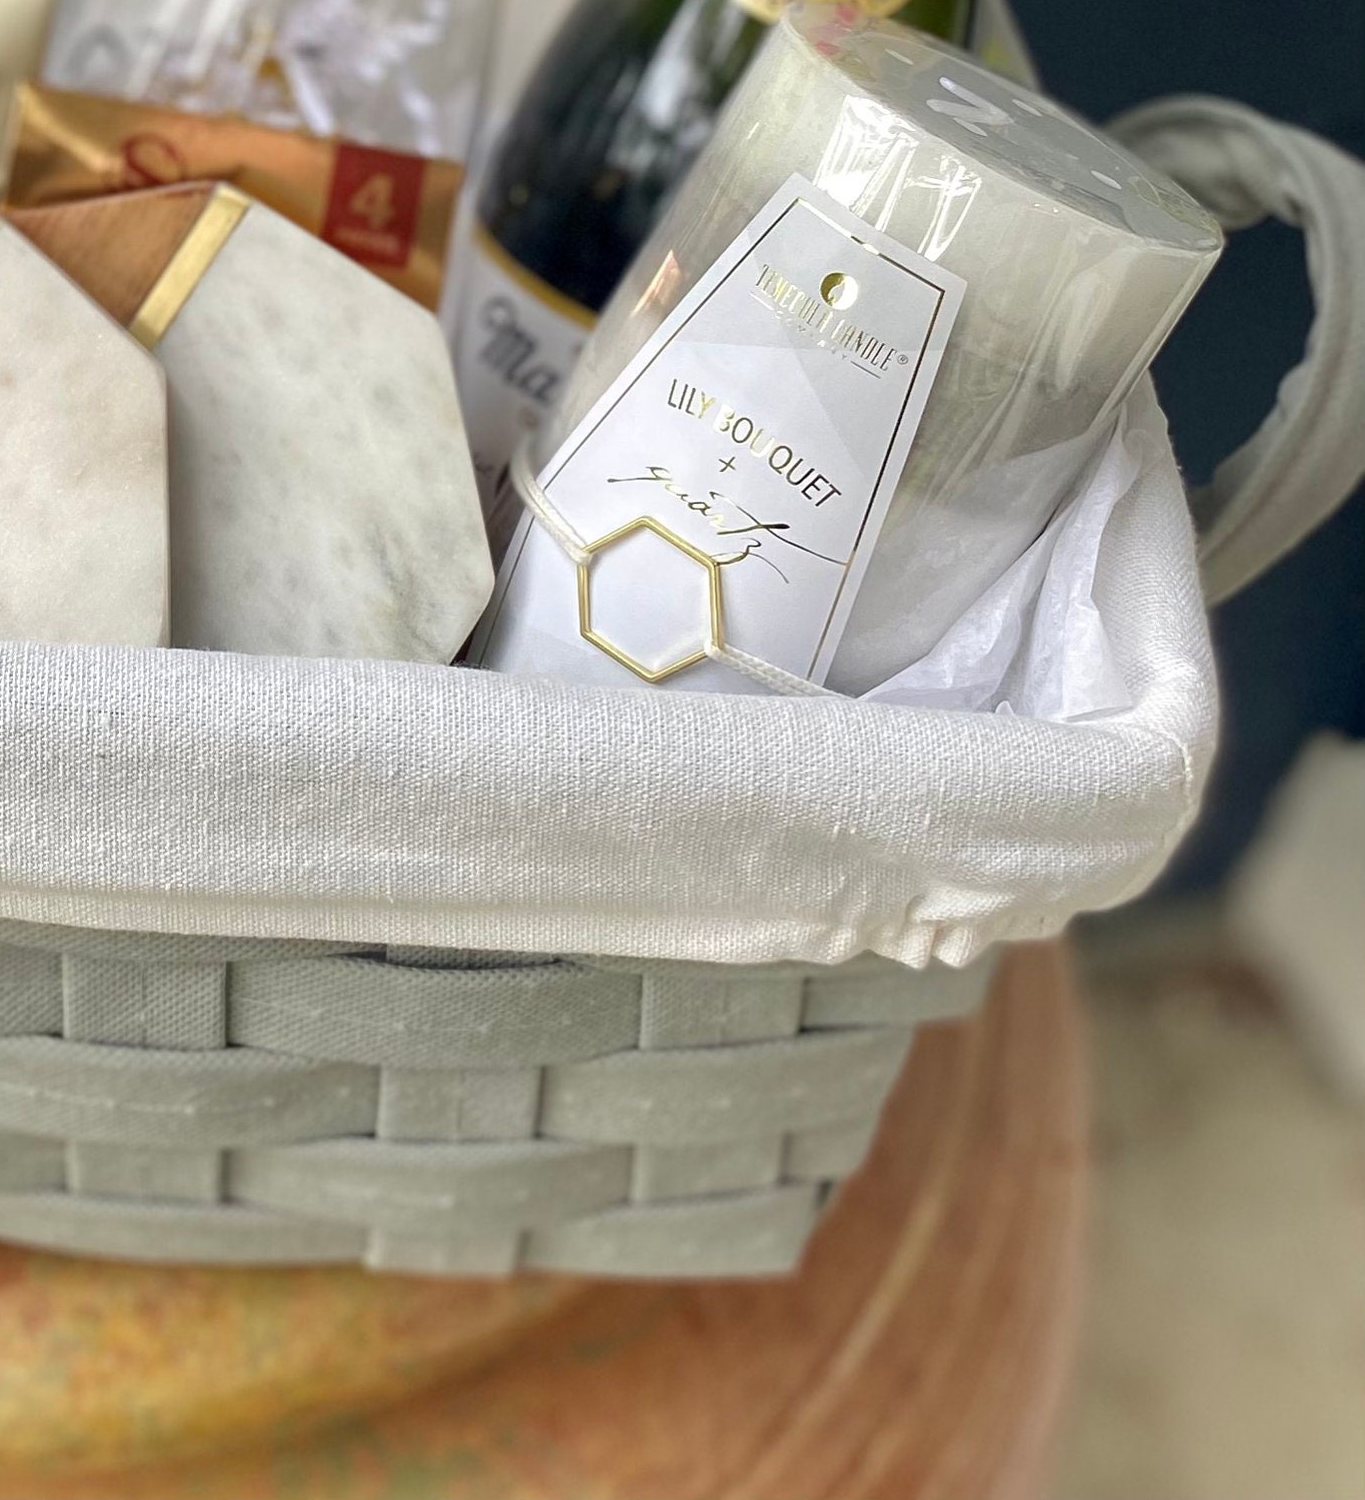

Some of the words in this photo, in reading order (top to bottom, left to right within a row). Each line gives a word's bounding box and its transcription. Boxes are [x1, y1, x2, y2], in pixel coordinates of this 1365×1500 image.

[348, 171, 396, 231] 4
[755, 263, 834, 334] TEMECULA
[666, 378, 717, 420] LILY
[714, 403, 842, 508] BOUQUET
